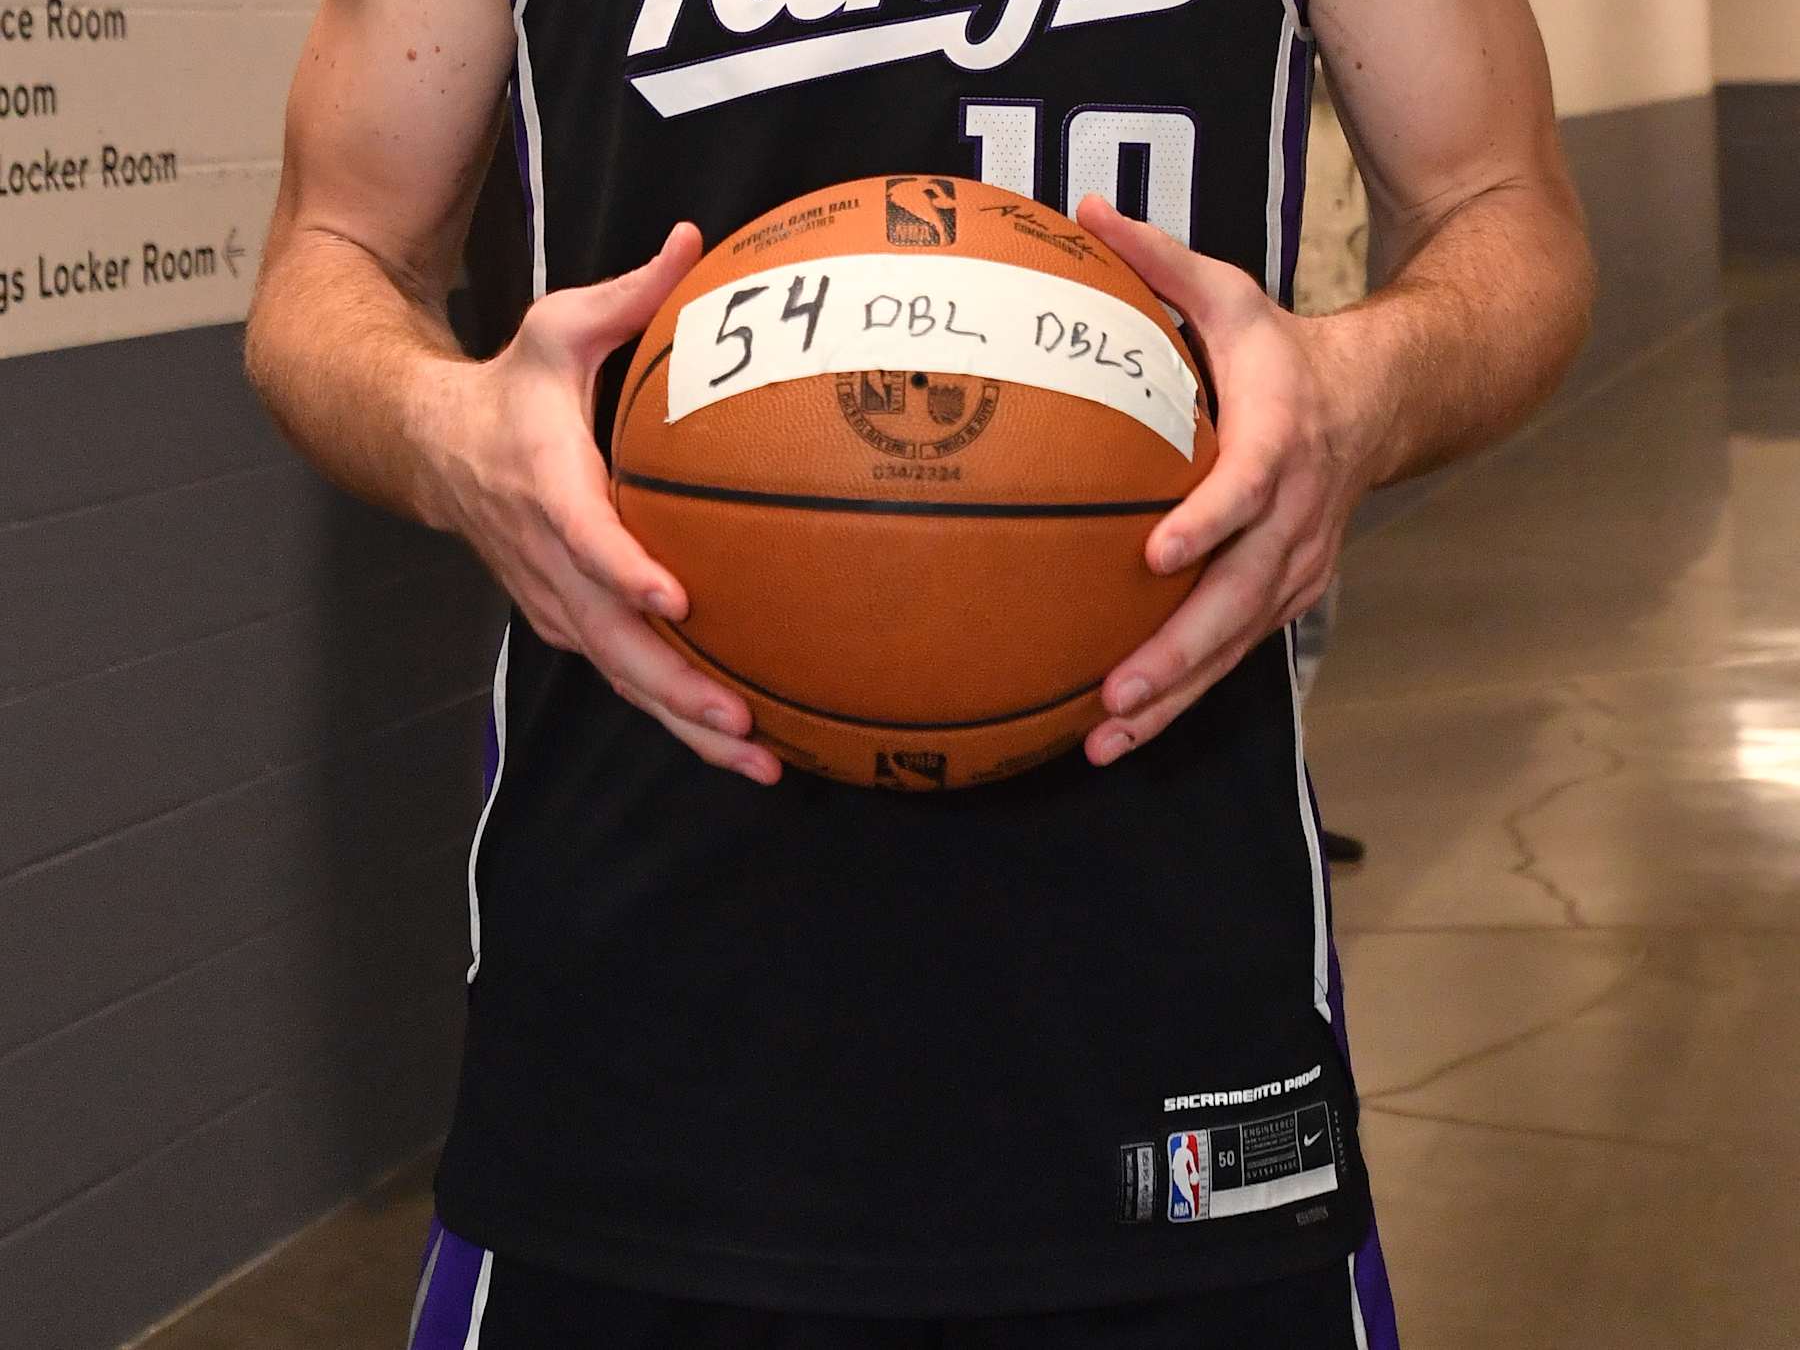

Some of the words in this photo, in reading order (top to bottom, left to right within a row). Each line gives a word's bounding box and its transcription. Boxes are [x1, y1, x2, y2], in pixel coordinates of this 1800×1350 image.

[0, 9, 33, 41] ce
[0, 149, 89, 196] ocker
[101, 145, 178, 189] Room
[788, 206, 824, 227] GAME
[828, 198, 861, 214] BALL
[38, 250, 130, 300] Locker
[142, 241, 217, 285] Room
[709, 275, 831, 388] 54
[863, 294, 988, 344] DBL
[1164, 1081, 1282, 1112] SACRAMENTO
[1218, 1150, 1235, 1168] 50
[1173, 1202, 1190, 1217] NBA
